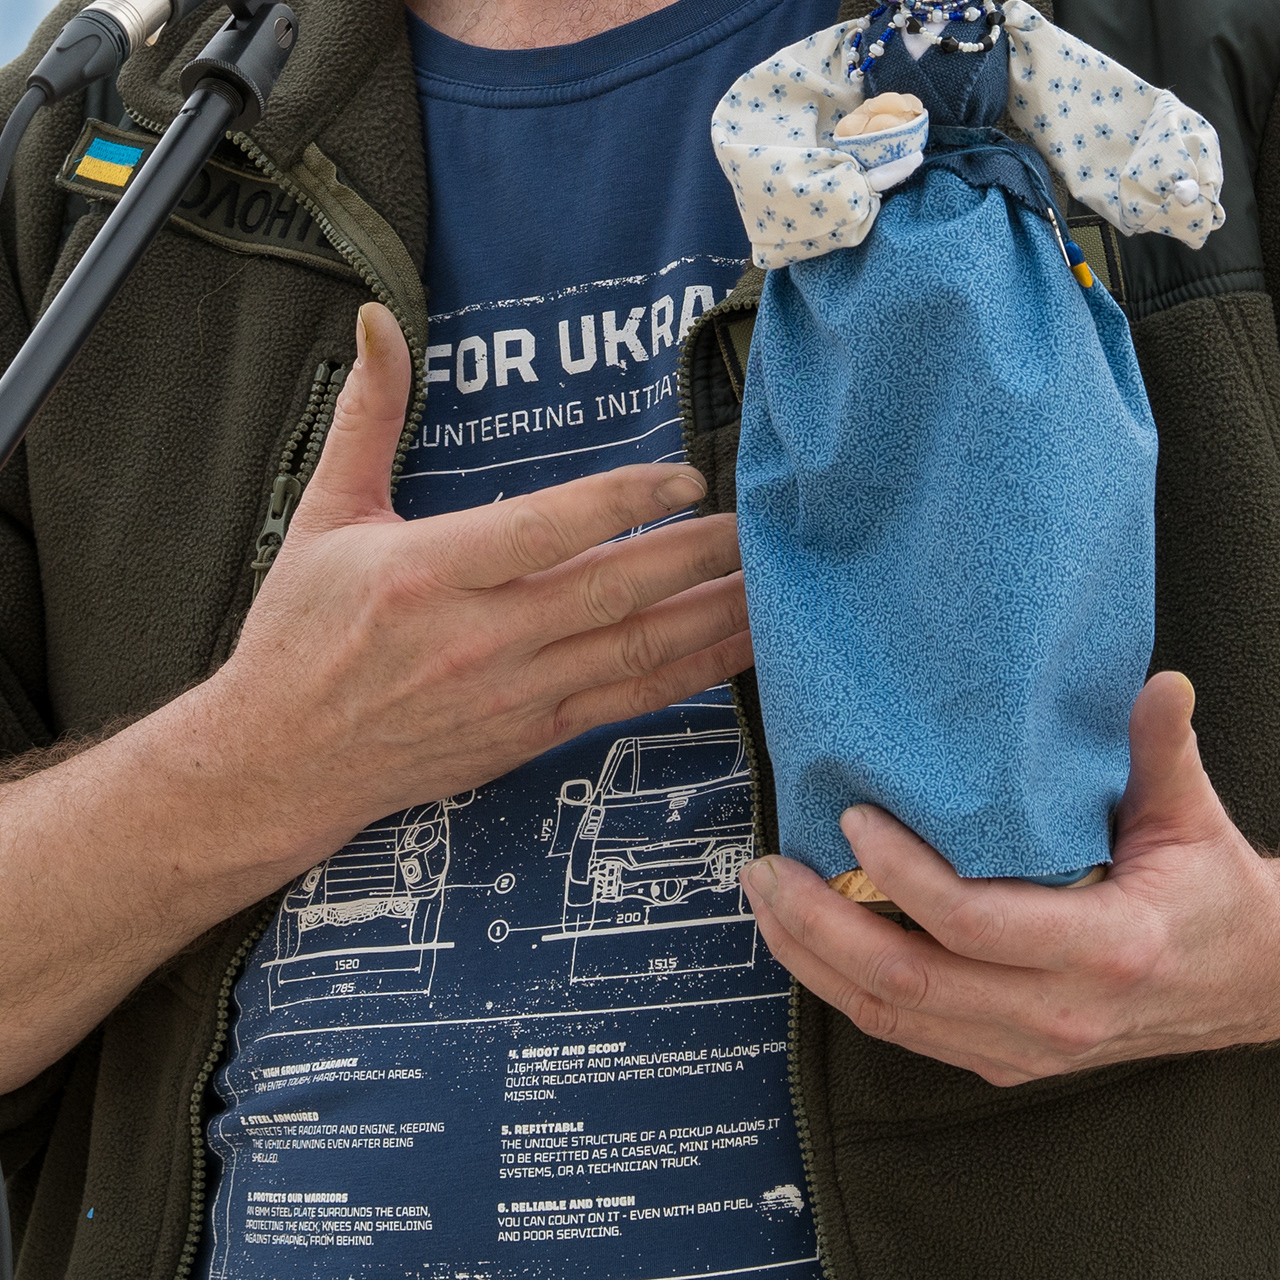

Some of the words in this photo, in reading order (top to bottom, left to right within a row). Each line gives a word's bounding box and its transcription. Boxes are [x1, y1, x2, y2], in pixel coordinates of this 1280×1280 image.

[423, 327, 538, 395] FOR
[558, 284, 733, 376] UKRA
[540, 818, 554, 842] 475
[616, 910, 641, 924] 200
[334, 958, 360, 970] 1520
[647, 956, 677, 971] 1515
[330, 982, 355, 995] 1785
[507, 1059, 584, 1074] LIGHTWEIGHT
[587, 1056, 611, 1068] AND
[614, 1050, 707, 1067] MANEUVERABLE
[710, 1045, 760, 1058] ALLOWS
[763, 1041, 787, 1054] FOR
[508, 1050, 520, 1060] 4.
[521, 1046, 560, 1058] SHOOT
[561, 1044, 586, 1056] AND
[587, 1042, 627, 1055] SCOOT
[262, 1065, 280, 1079] HIGH
[280, 1062, 311, 1076] GROUND
[311, 1057, 359, 1071] CLEARANCE
[505, 1075, 539, 1088] QUICK
[542, 1071, 615, 1086] RELOCATION
[618, 1069, 654, 1081] AFTER
[657, 1063, 733, 1078] COMPLETING
[735, 1060, 744, 1071] A
[267, 1079, 287, 1091] ENTER
[504, 1089, 557, 1102] MISSION.
[248, 1113, 272, 1125] STEEL
[273, 1111, 319, 1123] ARMOURED
[246, 1126, 282, 1136] PROTECTS
[283, 1125, 298, 1136] THE
[298, 1124, 338, 1135] RADIATOR
[339, 1124, 358, 1134] AND
[360, 1123, 398, 1136] ENGINE,
[400, 1122, 445, 1134] KEEPING
[501, 1124, 512, 1136] 5.
[514, 1121, 584, 1135] REFITTABLE
[501, 1138, 522, 1150] THE
[524, 1136, 568, 1149] UNIQUE
[571, 1132, 637, 1147] STRUCTURE
[640, 1131, 656, 1143] OF
[658, 1130, 667, 1141] A
[670, 1126, 713, 1140] PICKUP
[715, 1121, 765, 1135] ALLOWS
[768, 1118, 780, 1130] IT
[252, 1139, 263, 1149] THE
[264, 1139, 291, 1149] VEHICLE
[292, 1138, 326, 1149] RUNNING
[327, 1138, 350, 1149] EVEN
[351, 1138, 381, 1148] AFTER
[383, 1137, 413, 1148] BEING
[500, 1153, 515, 1164] TO
[517, 1152, 532, 1163] BE
[534, 1149, 589, 1162] REFITTED
[591, 1148, 608, 1159] AS
[610, 1147, 619, 1158] A
[621, 1143, 677, 1158] CASEVAC,
[679, 1139, 709, 1152] MINI
[711, 1135, 759, 1149] HIMARS
[499, 1166, 555, 1179] SYSTEMS,
[558, 1165, 574, 1177] OR
[576, 1164, 585, 1175] A
[587, 1160, 658, 1175] TECHNICIAN
[660, 1155, 702, 1169] TRUCK.
[253, 1192, 287, 1203] PROTECTS
[287, 1193, 303, 1203] OUR
[304, 1193, 349, 1203] WARRIORS
[497, 1202, 510, 1213] 6.
[511, 1199, 567, 1213] RELIABLE
[569, 1198, 593, 1210] AND
[595, 1195, 636, 1208] TOUGH
[271, 1207, 292, 1217] STEEL
[293, 1207, 316, 1218] PLATE
[317, 1207, 372, 1217] SURROUNDS
[375, 1206, 394, 1217] THE
[396, 1206, 431, 1218] CABIN,
[498, 1216, 521, 1228] YOU
[548, 1213, 586, 1226] COUNT
[588, 1212, 605, 1224] ON
[607, 1211, 620, 1223] IT
[629, 1207, 661, 1221] EVEN
[663, 1204, 695, 1217] WITH
[697, 1201, 721, 1214] BAD
[723, 1198, 753, 1211] FUEL
[245, 1219, 284, 1231] PROTECTING
[285, 1221, 298, 1231] THE
[321, 1220, 351, 1232] KNEES
[353, 1221, 373, 1231] AND
[375, 1220, 433, 1231] SHIELDING
[245, 1233, 271, 1244] AGAINST
[310, 1235, 334, 1245] FROM
[336, 1235, 375, 1246] BEHIND.
[497, 1230, 521, 1242] AND
[523, 1228, 554, 1241] POOR
[556, 1225, 623, 1240] SERVICING.
